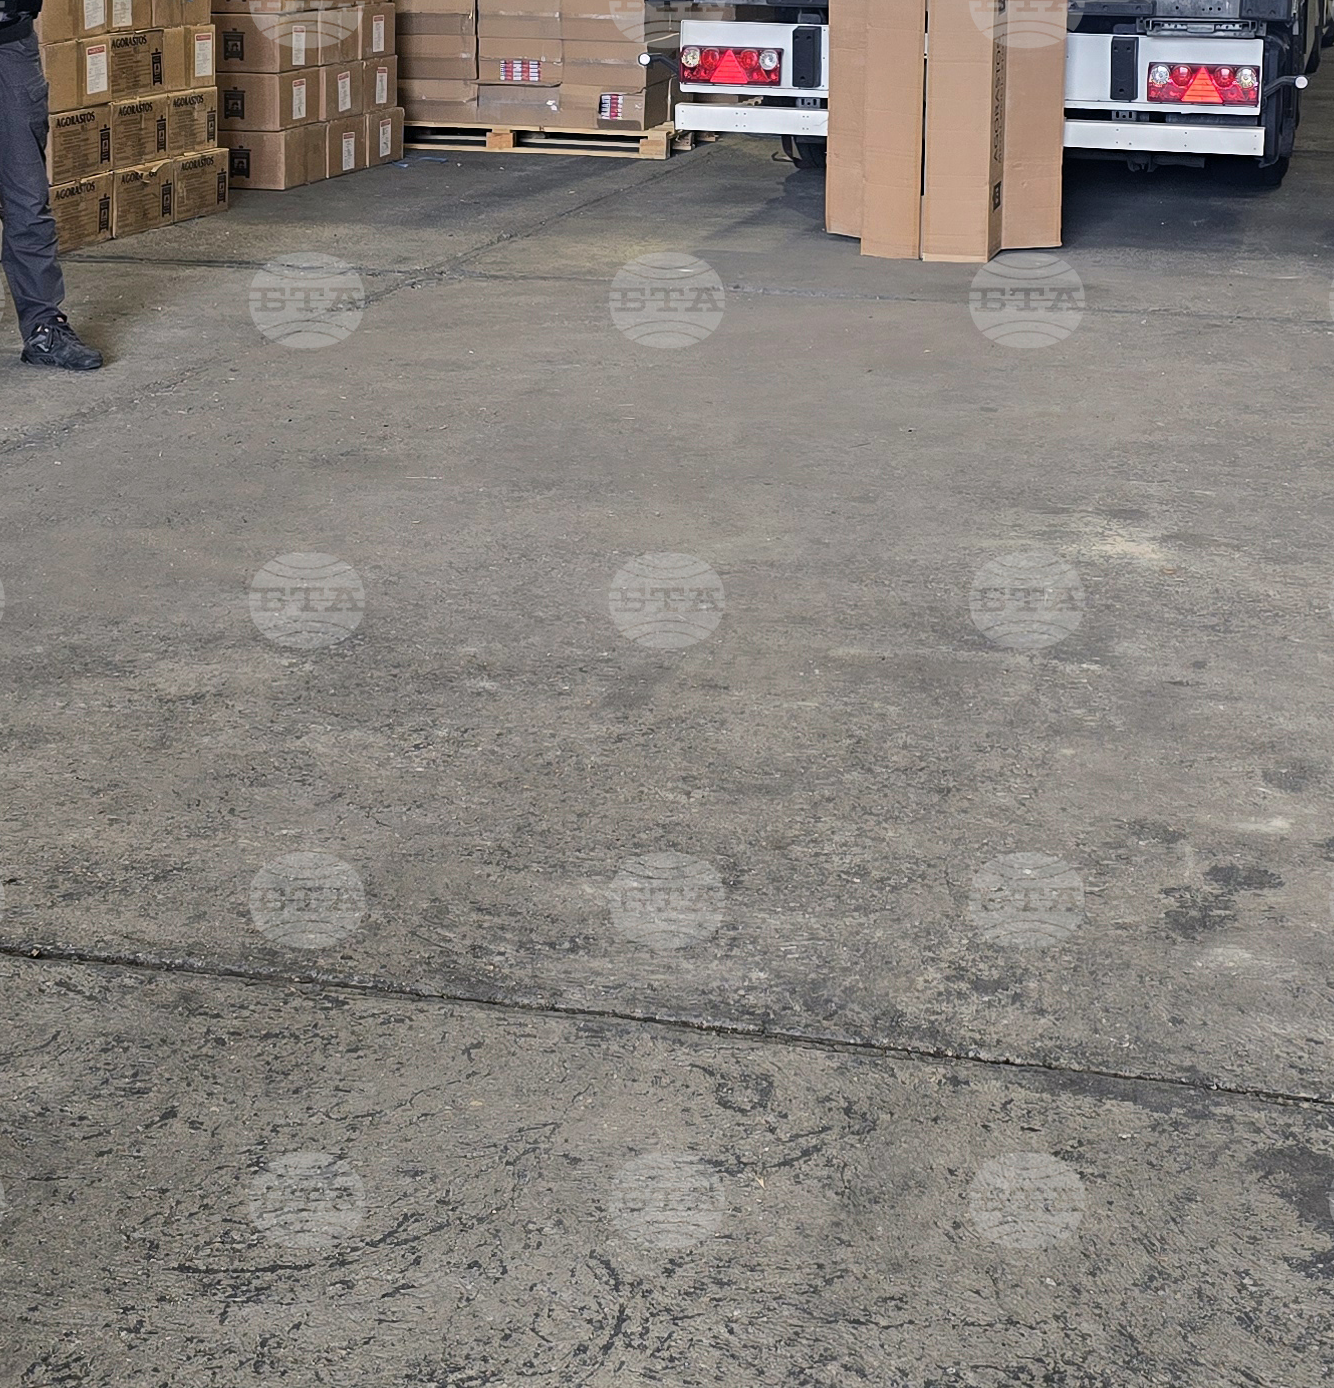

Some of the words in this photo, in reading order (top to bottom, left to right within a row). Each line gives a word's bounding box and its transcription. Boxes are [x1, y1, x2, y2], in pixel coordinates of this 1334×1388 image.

[111, 34, 147, 50] AGORASTOS
[172, 94, 204, 108] AGORASTOS
[119, 102, 153, 116] AGORASTOS
[56, 111, 96, 128] AGORASTOS
[180, 156, 214, 171] AGORASTOS
[54, 181, 96, 201] AGORASTOS
